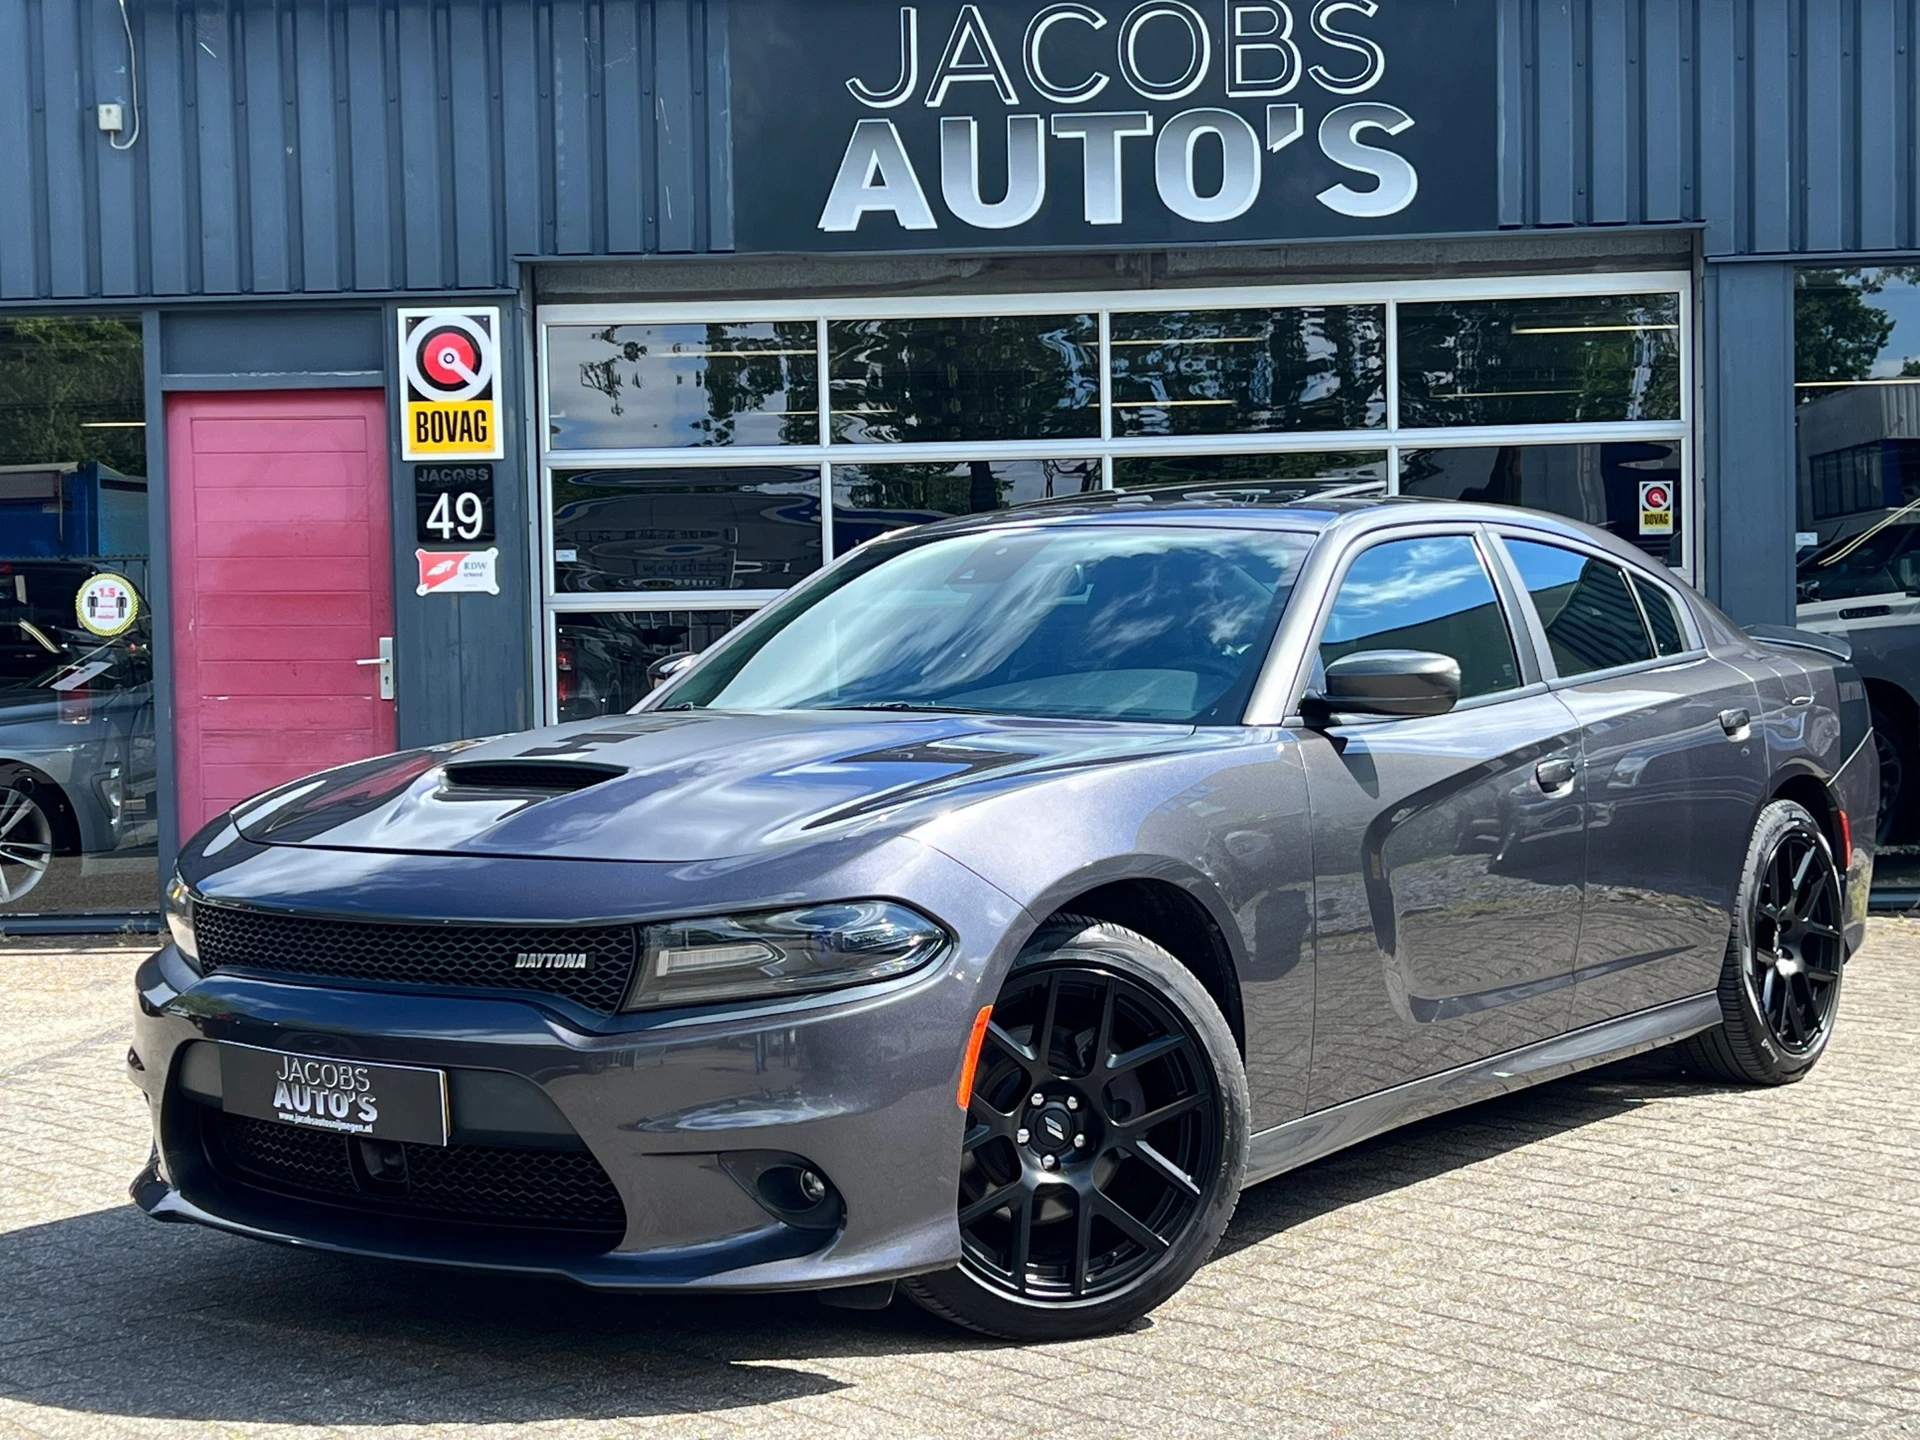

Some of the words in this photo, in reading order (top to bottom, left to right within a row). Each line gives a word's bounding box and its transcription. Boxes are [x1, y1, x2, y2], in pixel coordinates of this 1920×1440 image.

[845, 0, 1386, 108] JACOBS
[817, 101, 1419, 232] AUTO'S
[415, 409, 488, 443] BOVAG
[418, 468, 489, 483] JACOBS
[426, 491, 484, 540] 49
[463, 561, 488, 570] RDW
[515, 952, 587, 969] DAYTONA
[276, 1055, 371, 1092] JACOBS
[273, 1081, 378, 1122] AUTO'S
